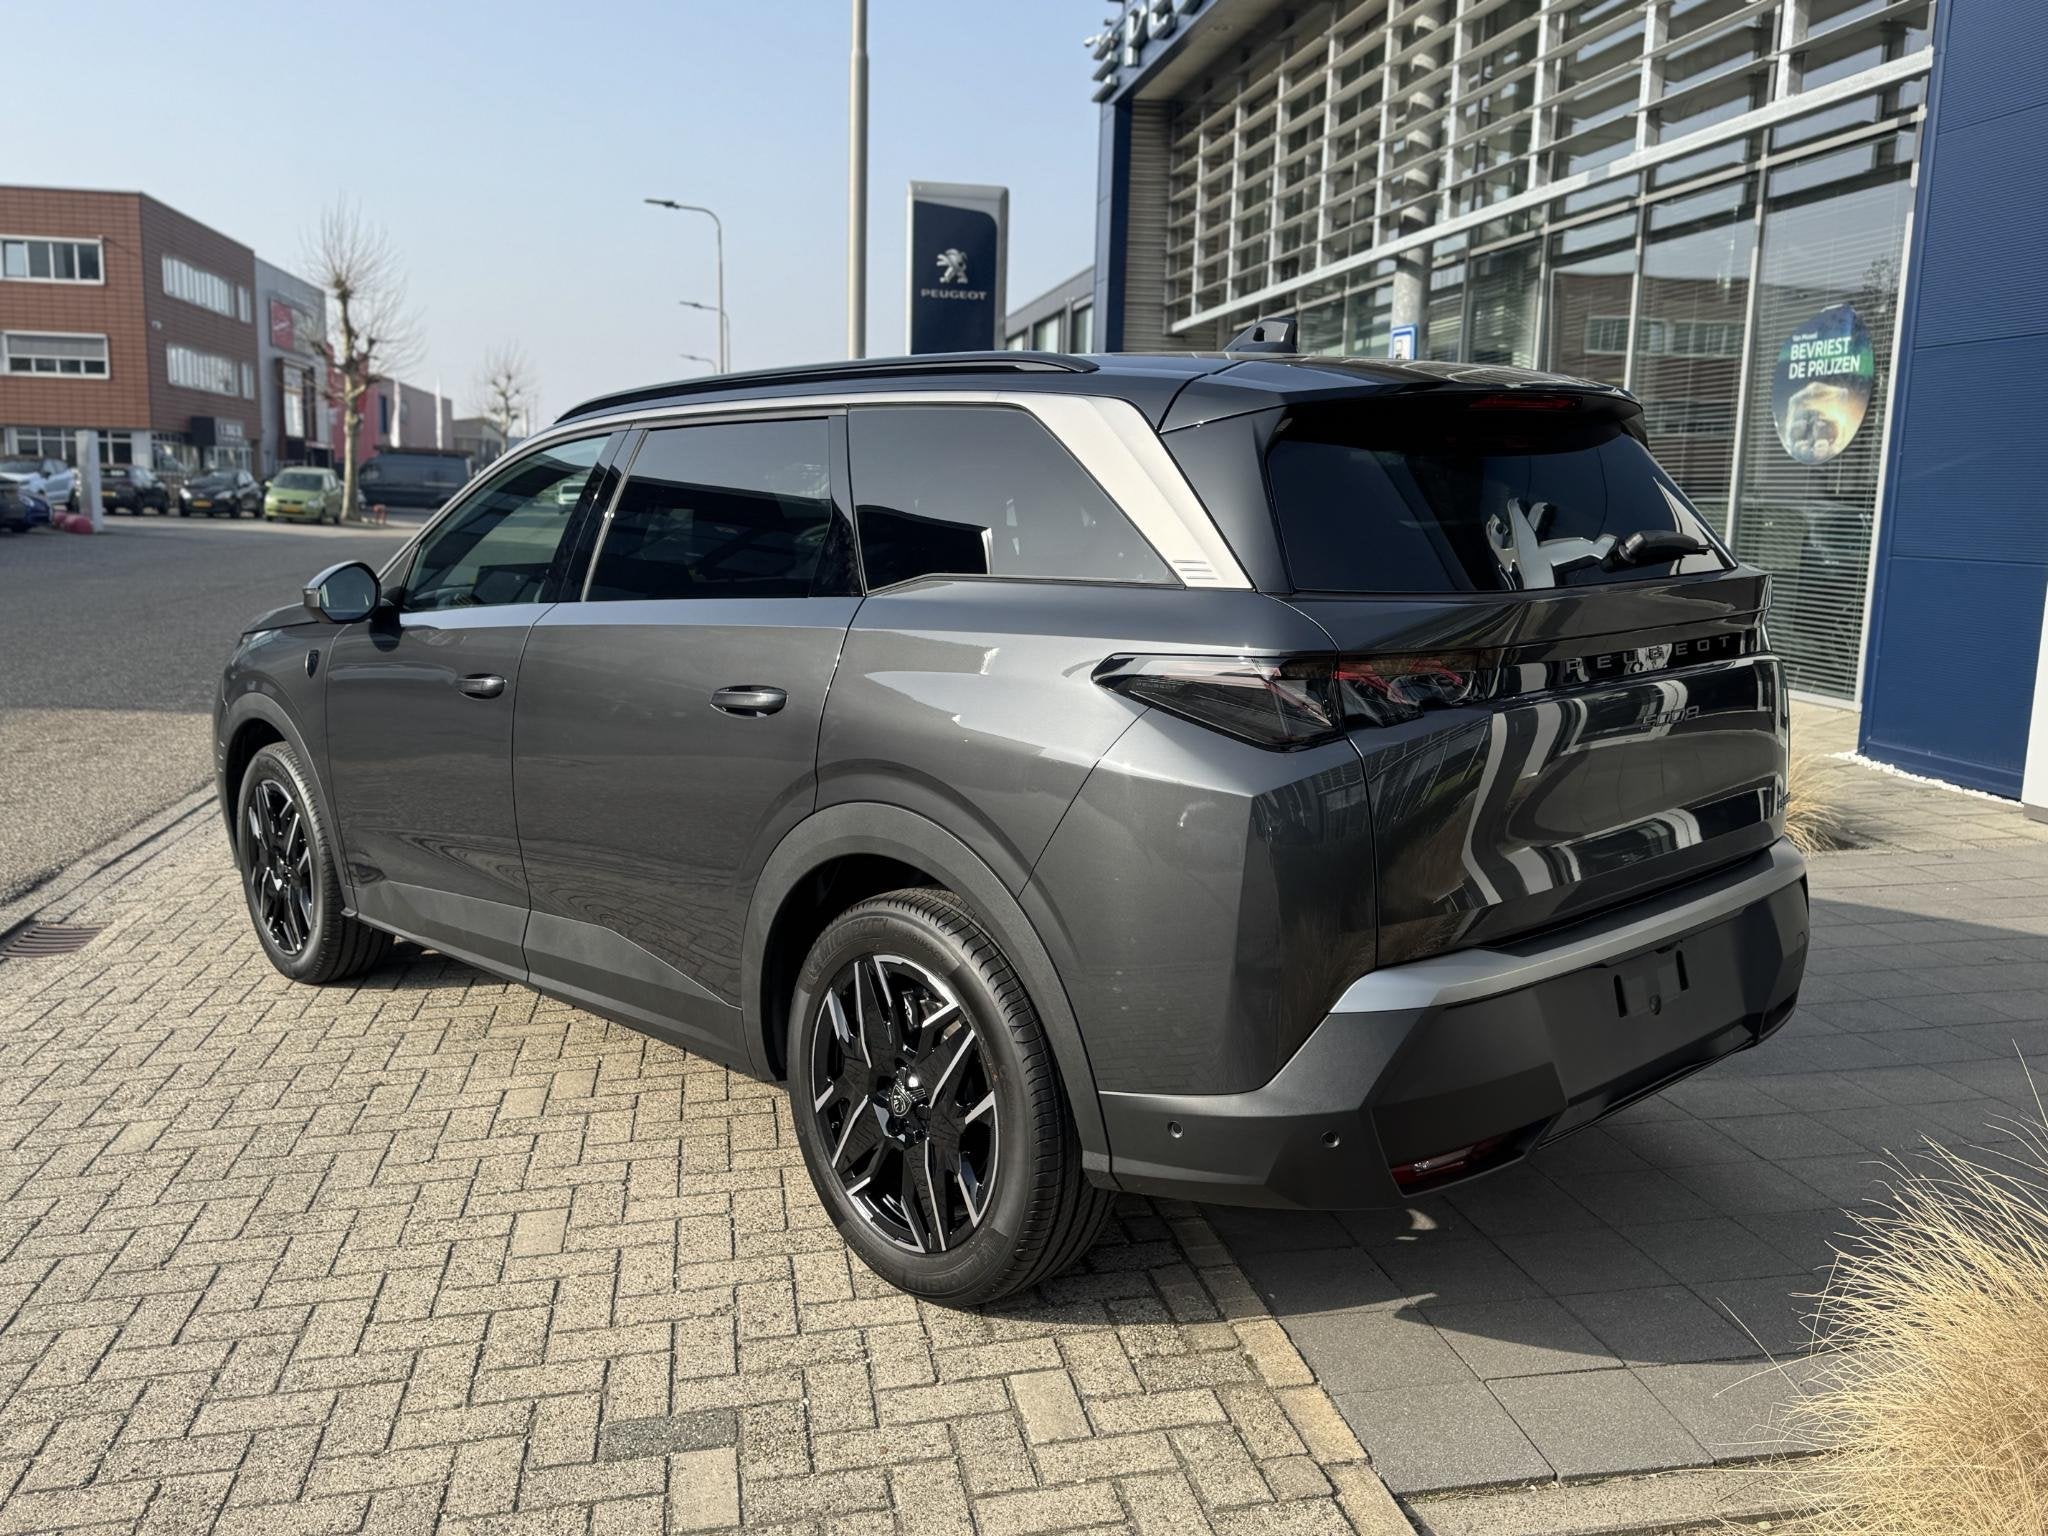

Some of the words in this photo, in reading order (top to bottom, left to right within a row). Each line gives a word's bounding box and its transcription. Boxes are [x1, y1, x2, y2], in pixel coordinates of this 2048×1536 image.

[921, 288, 987, 300] PEUGEOT
[1790, 336, 1851, 361] BEVRIEST
[1788, 361, 1806, 379] DE
[1807, 354, 1861, 378] PRIJZEN
[1566, 635, 1731, 675] PEUGEOT
